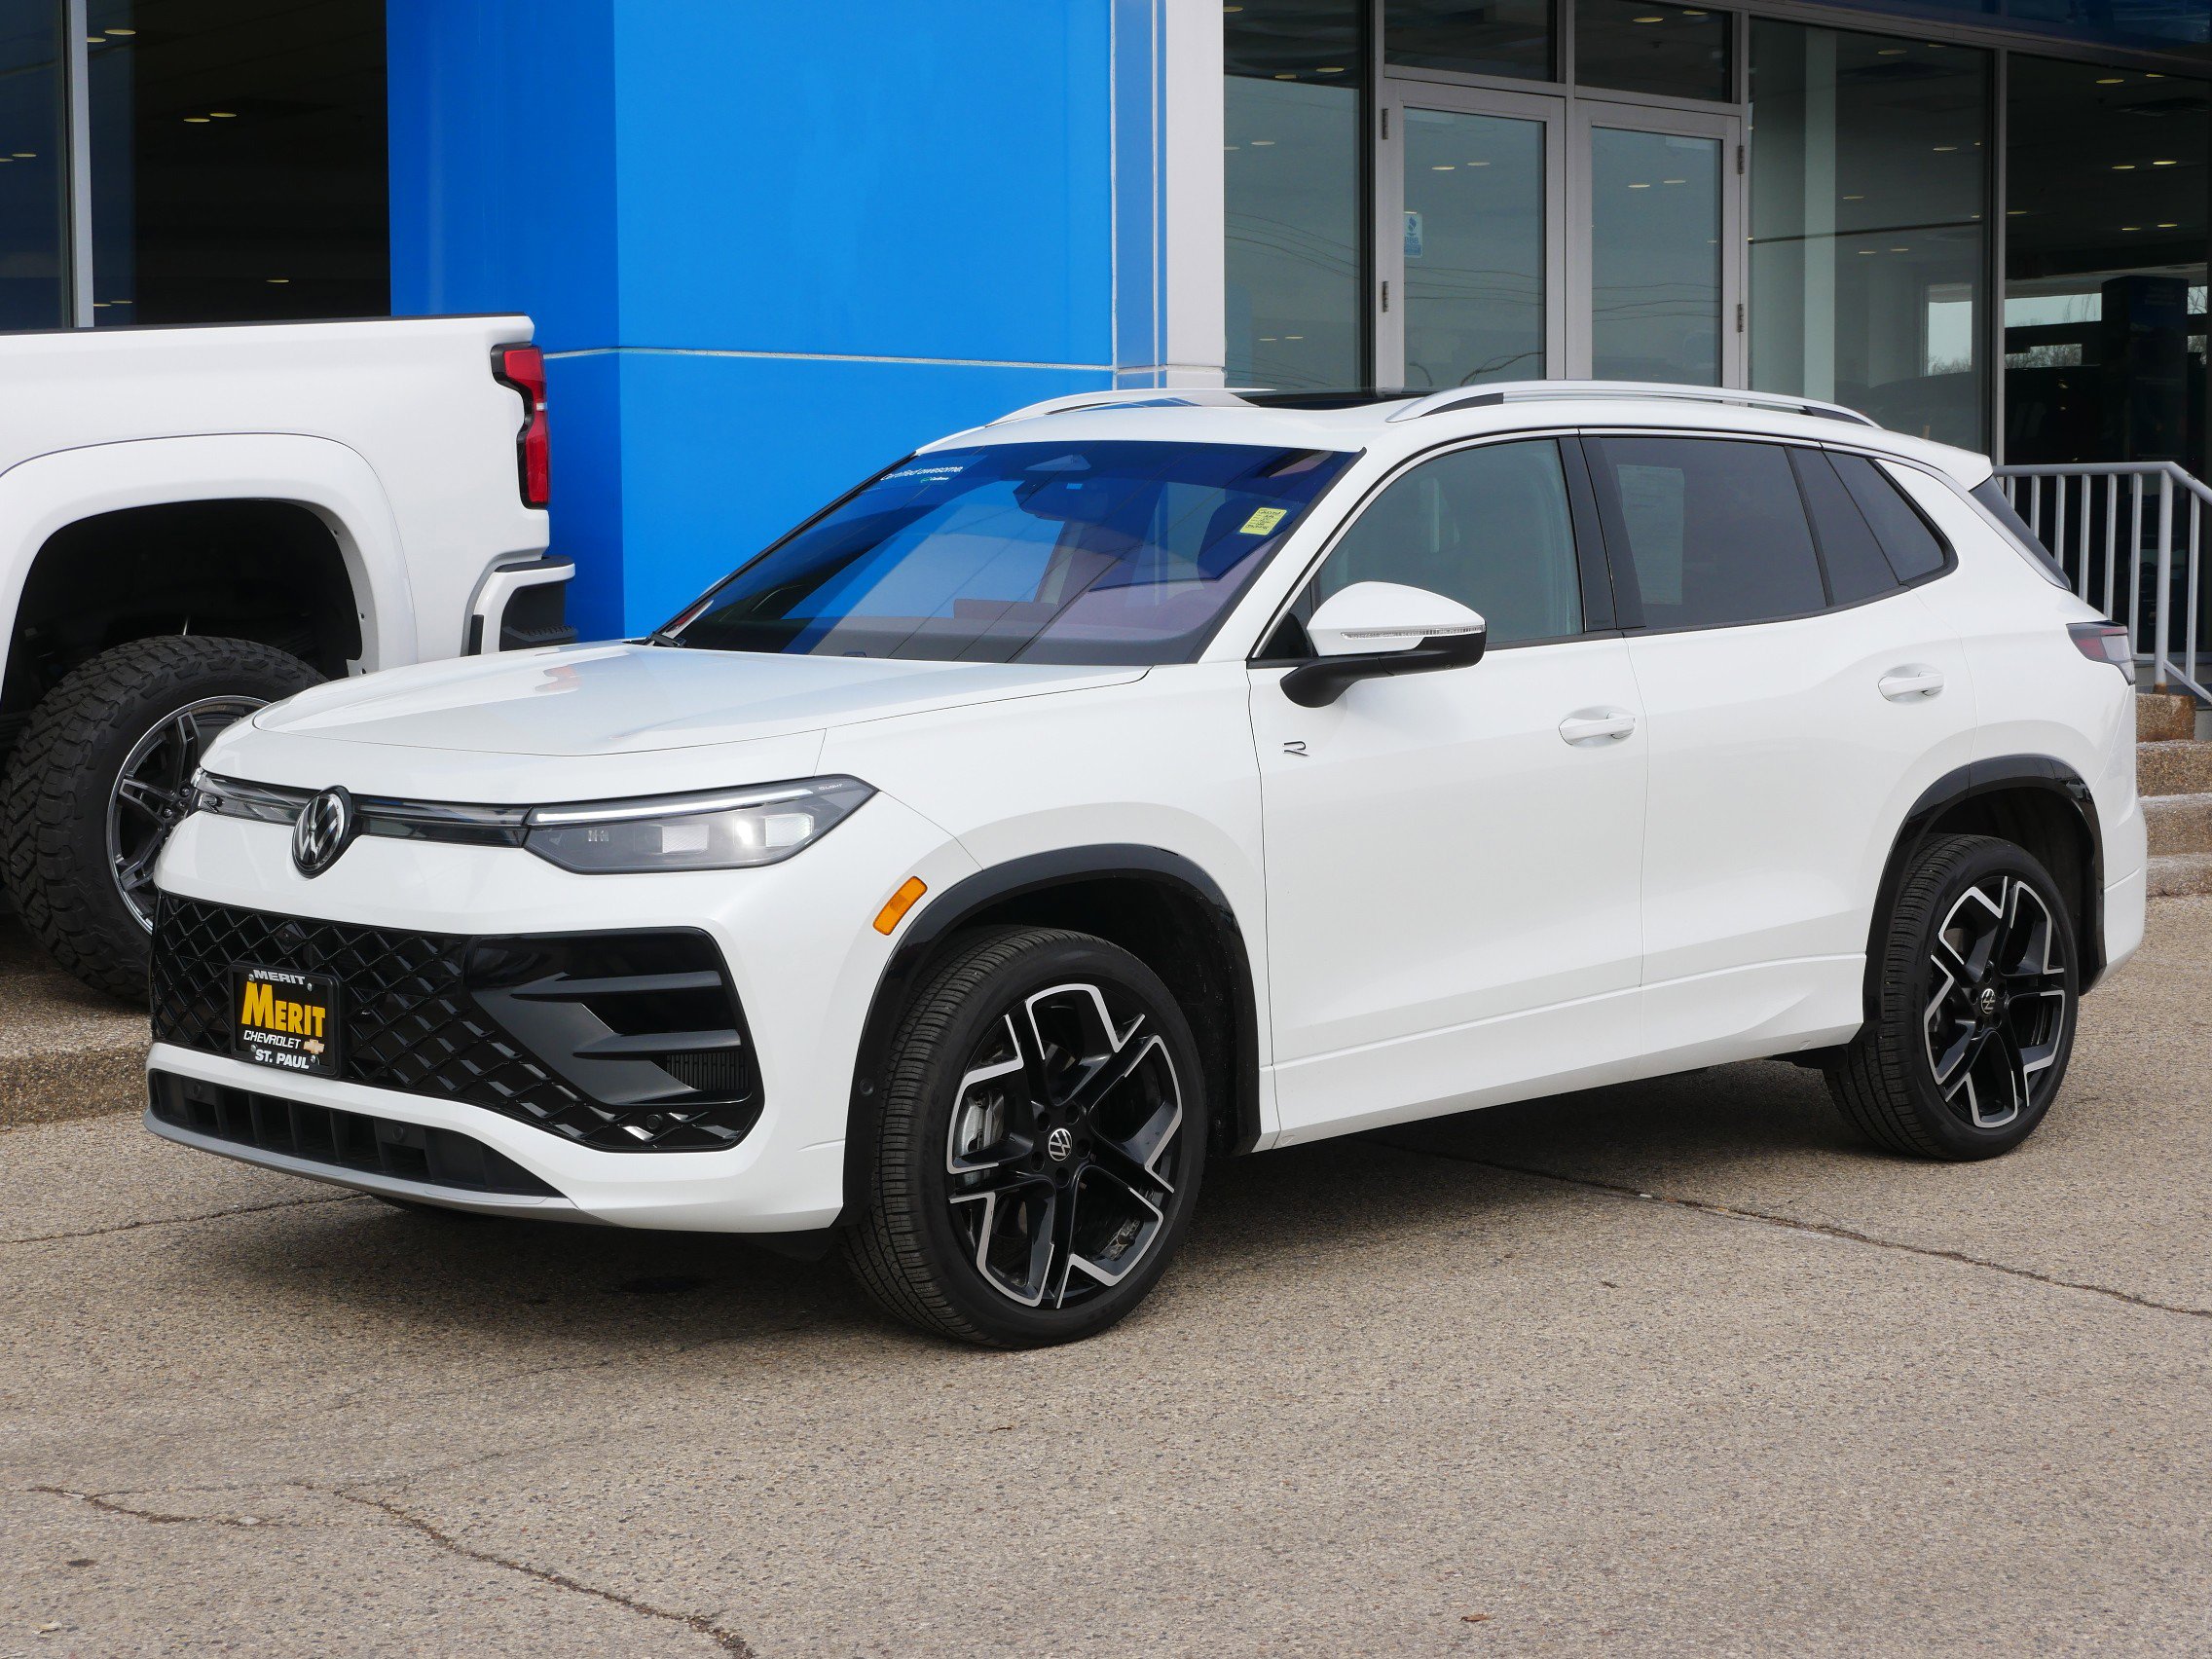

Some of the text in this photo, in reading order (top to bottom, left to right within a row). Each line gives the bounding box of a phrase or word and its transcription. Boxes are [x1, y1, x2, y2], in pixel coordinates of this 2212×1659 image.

[253, 969, 306, 985] MERIT
[243, 1030, 302, 1050] CHEVROLET
[254, 1049, 310, 1070] ST. PAUL
